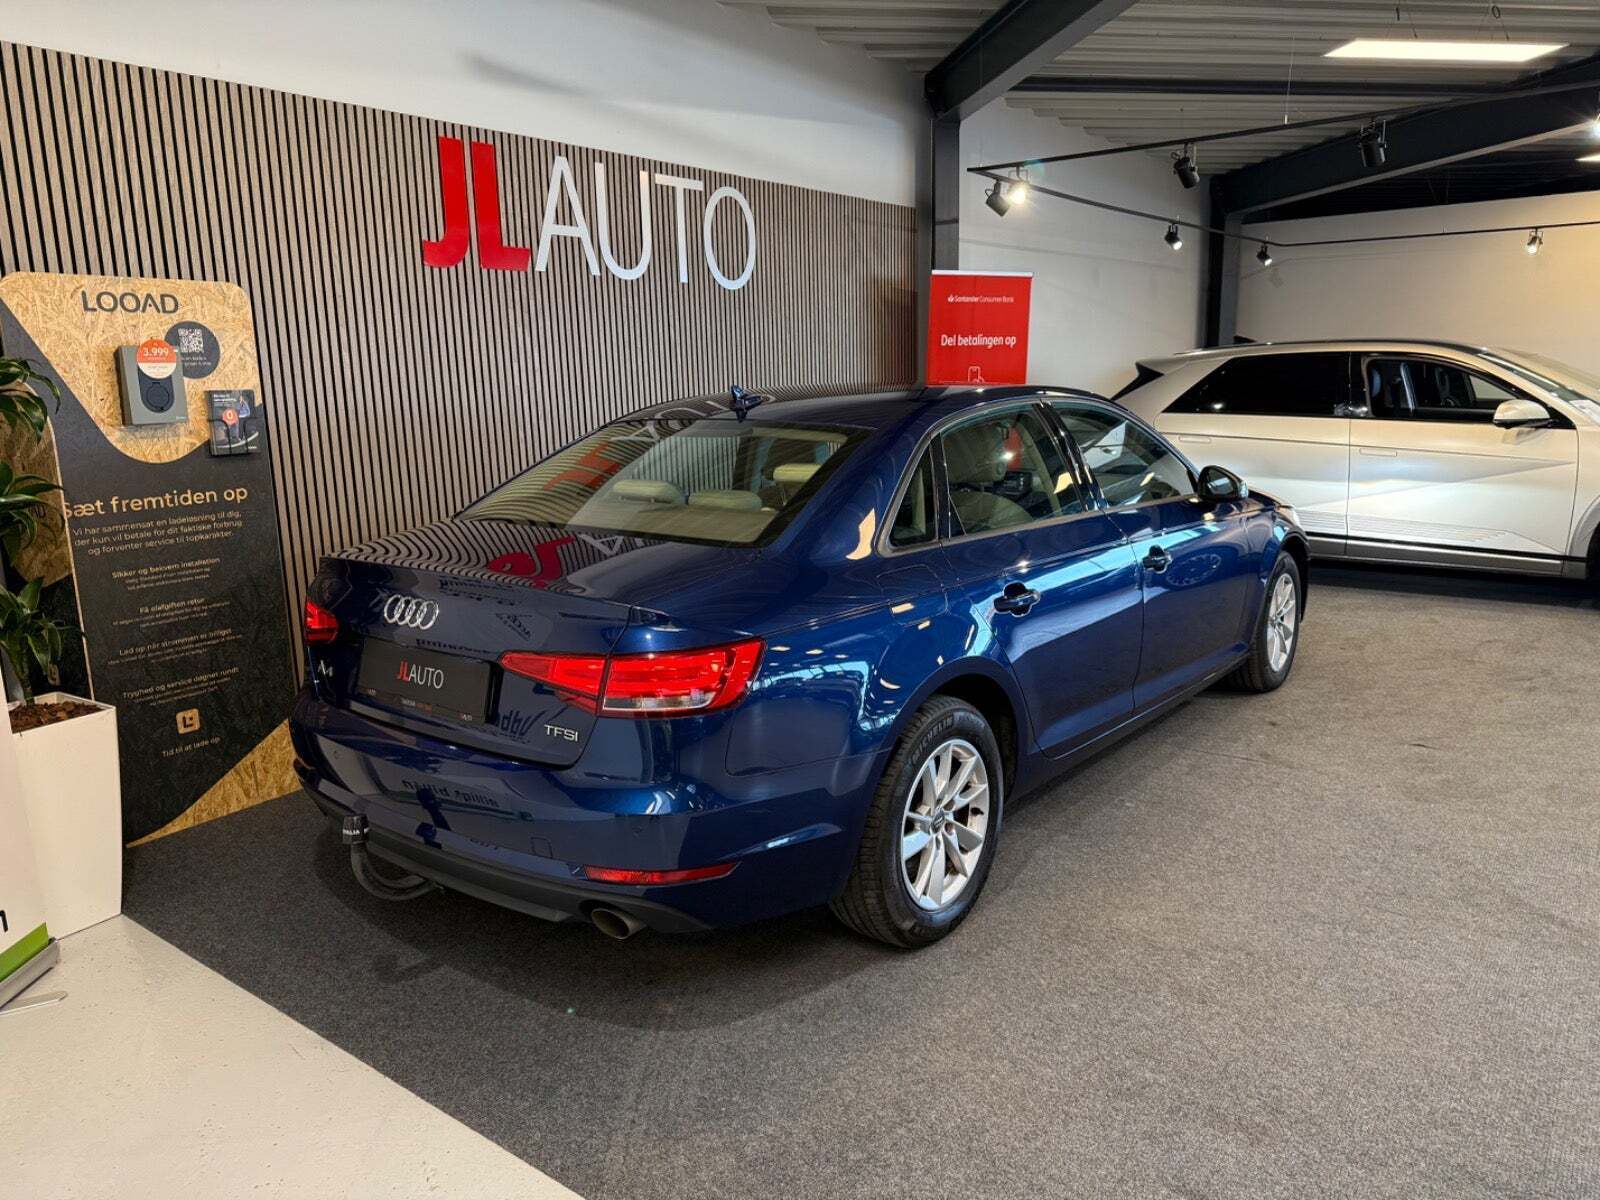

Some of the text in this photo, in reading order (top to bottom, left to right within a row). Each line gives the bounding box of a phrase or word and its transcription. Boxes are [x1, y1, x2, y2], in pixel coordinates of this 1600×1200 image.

[941, 334, 1017, 349] Del betalingen op
[111, 489, 217, 513] fremtiden
[223, 487, 248, 503] op
[72, 528, 83, 536] Vi
[84, 527, 100, 536] har
[156, 519, 167, 527] en
[75, 538, 90, 546] der
[92, 536, 111, 544] kun
[112, 533, 122, 542] vil
[124, 531, 152, 541] betale
[88, 548, 100, 556] og
[102, 542, 142, 553] forventer
[544, 724, 578, 742] TFSI
